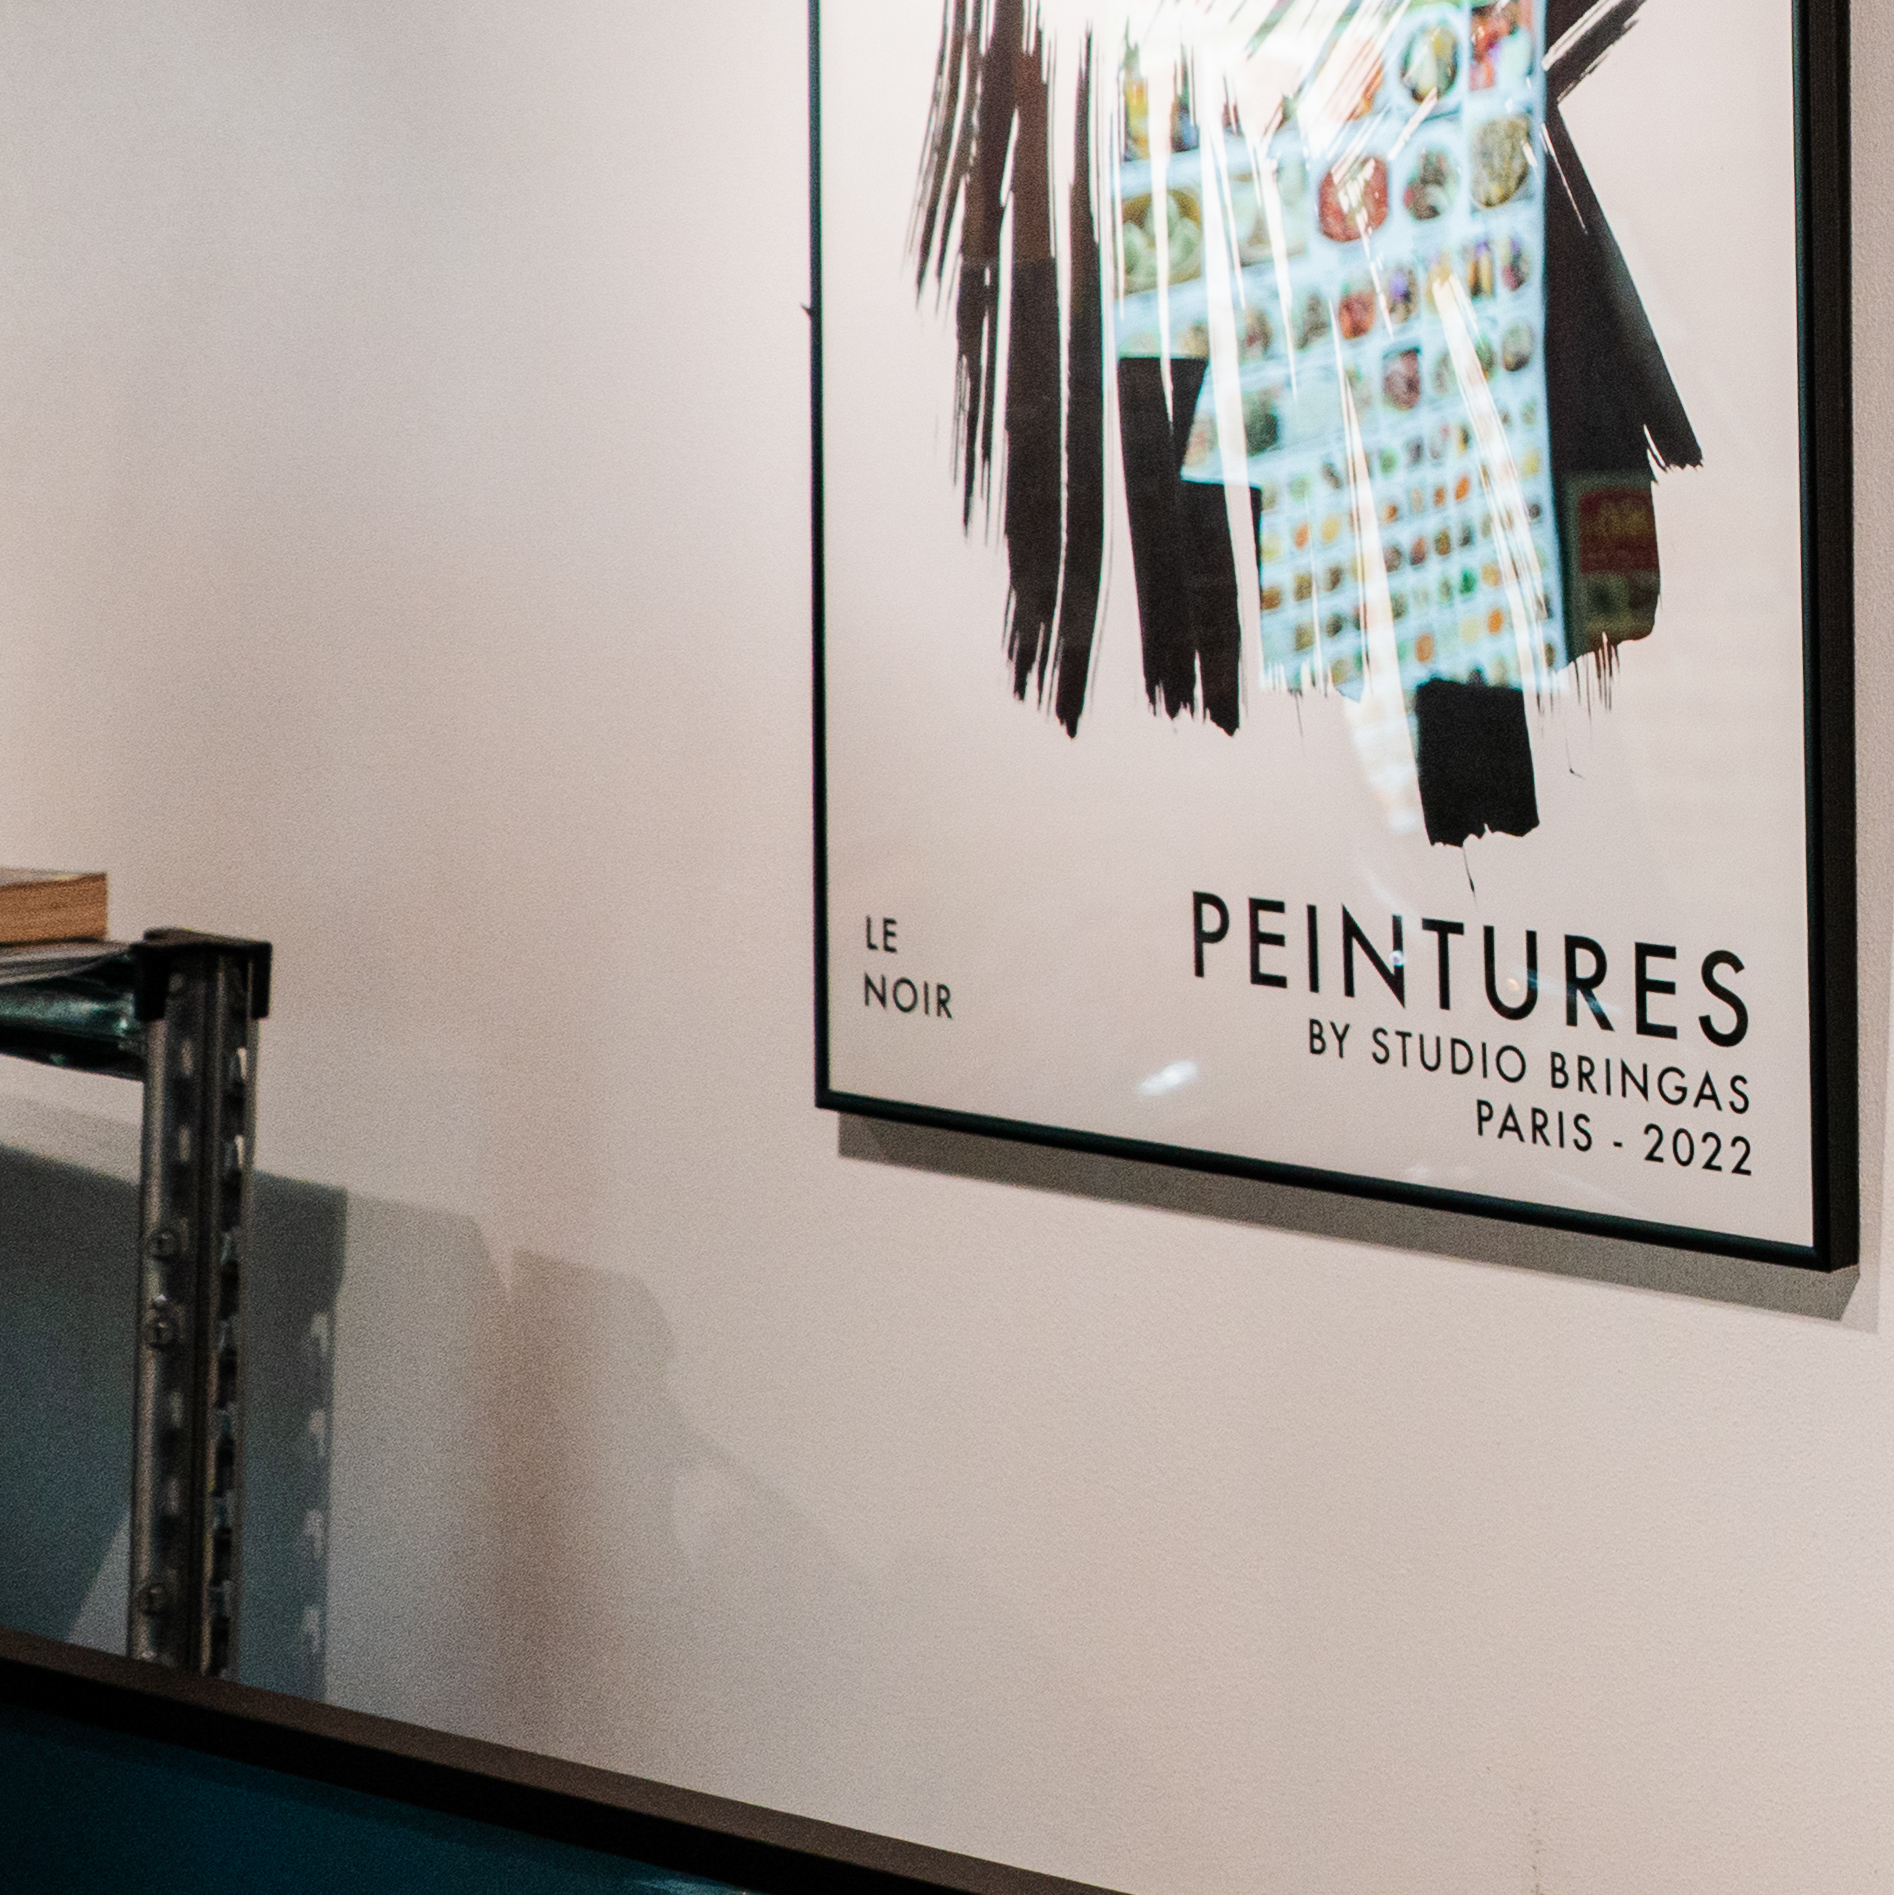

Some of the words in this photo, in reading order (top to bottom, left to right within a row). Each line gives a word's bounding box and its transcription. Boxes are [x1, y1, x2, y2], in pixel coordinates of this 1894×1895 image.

[866, 916, 898, 954] LE
[1192, 891, 1749, 1048] PEINTURES
[864, 973, 953, 1019] NOIR
[1309, 1018, 1350, 1059] BY
[1372, 1027, 1527, 1084] STUDIO
[1550, 1051, 1750, 1115] BRINGAS
[1476, 1099, 1593, 1152] PARIS
[1643, 1123, 1752, 1177] 2022
